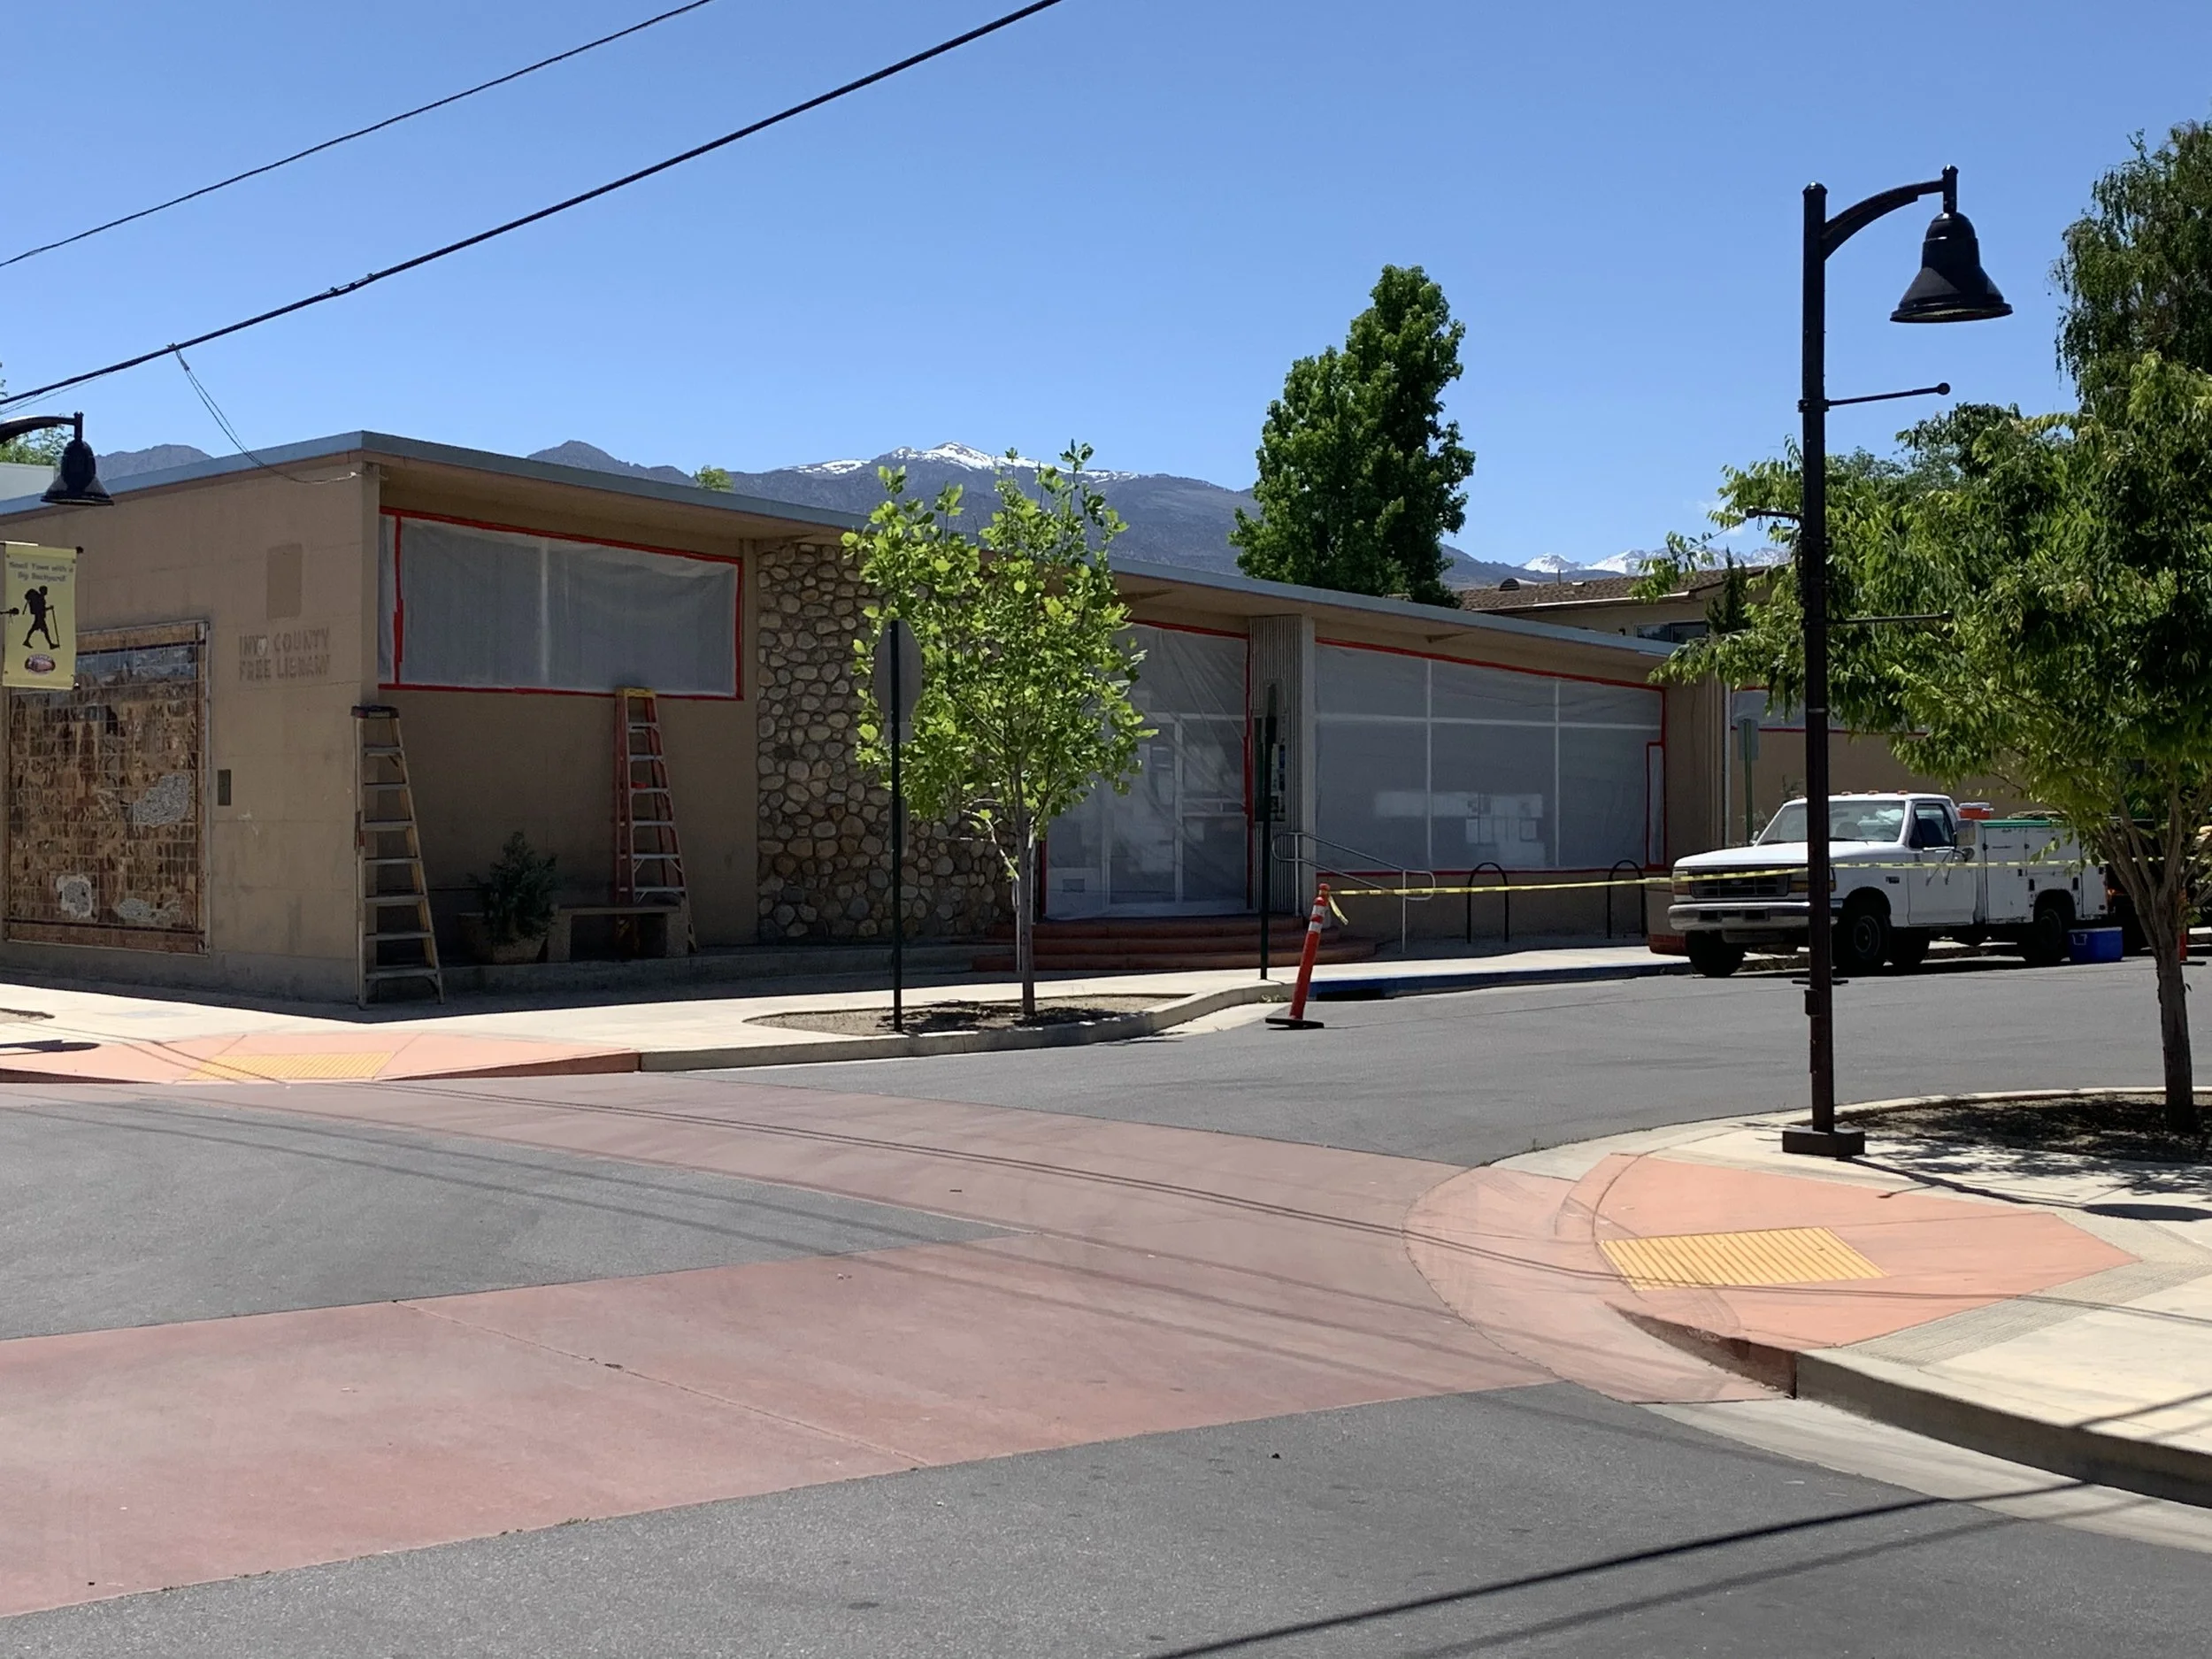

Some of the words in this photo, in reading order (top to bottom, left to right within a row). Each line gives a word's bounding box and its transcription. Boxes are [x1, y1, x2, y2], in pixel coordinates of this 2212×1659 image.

[273, 626, 330, 653] COUNTY
[239, 658, 271, 681] FREE
[277, 653, 331, 680] LIBRARY
